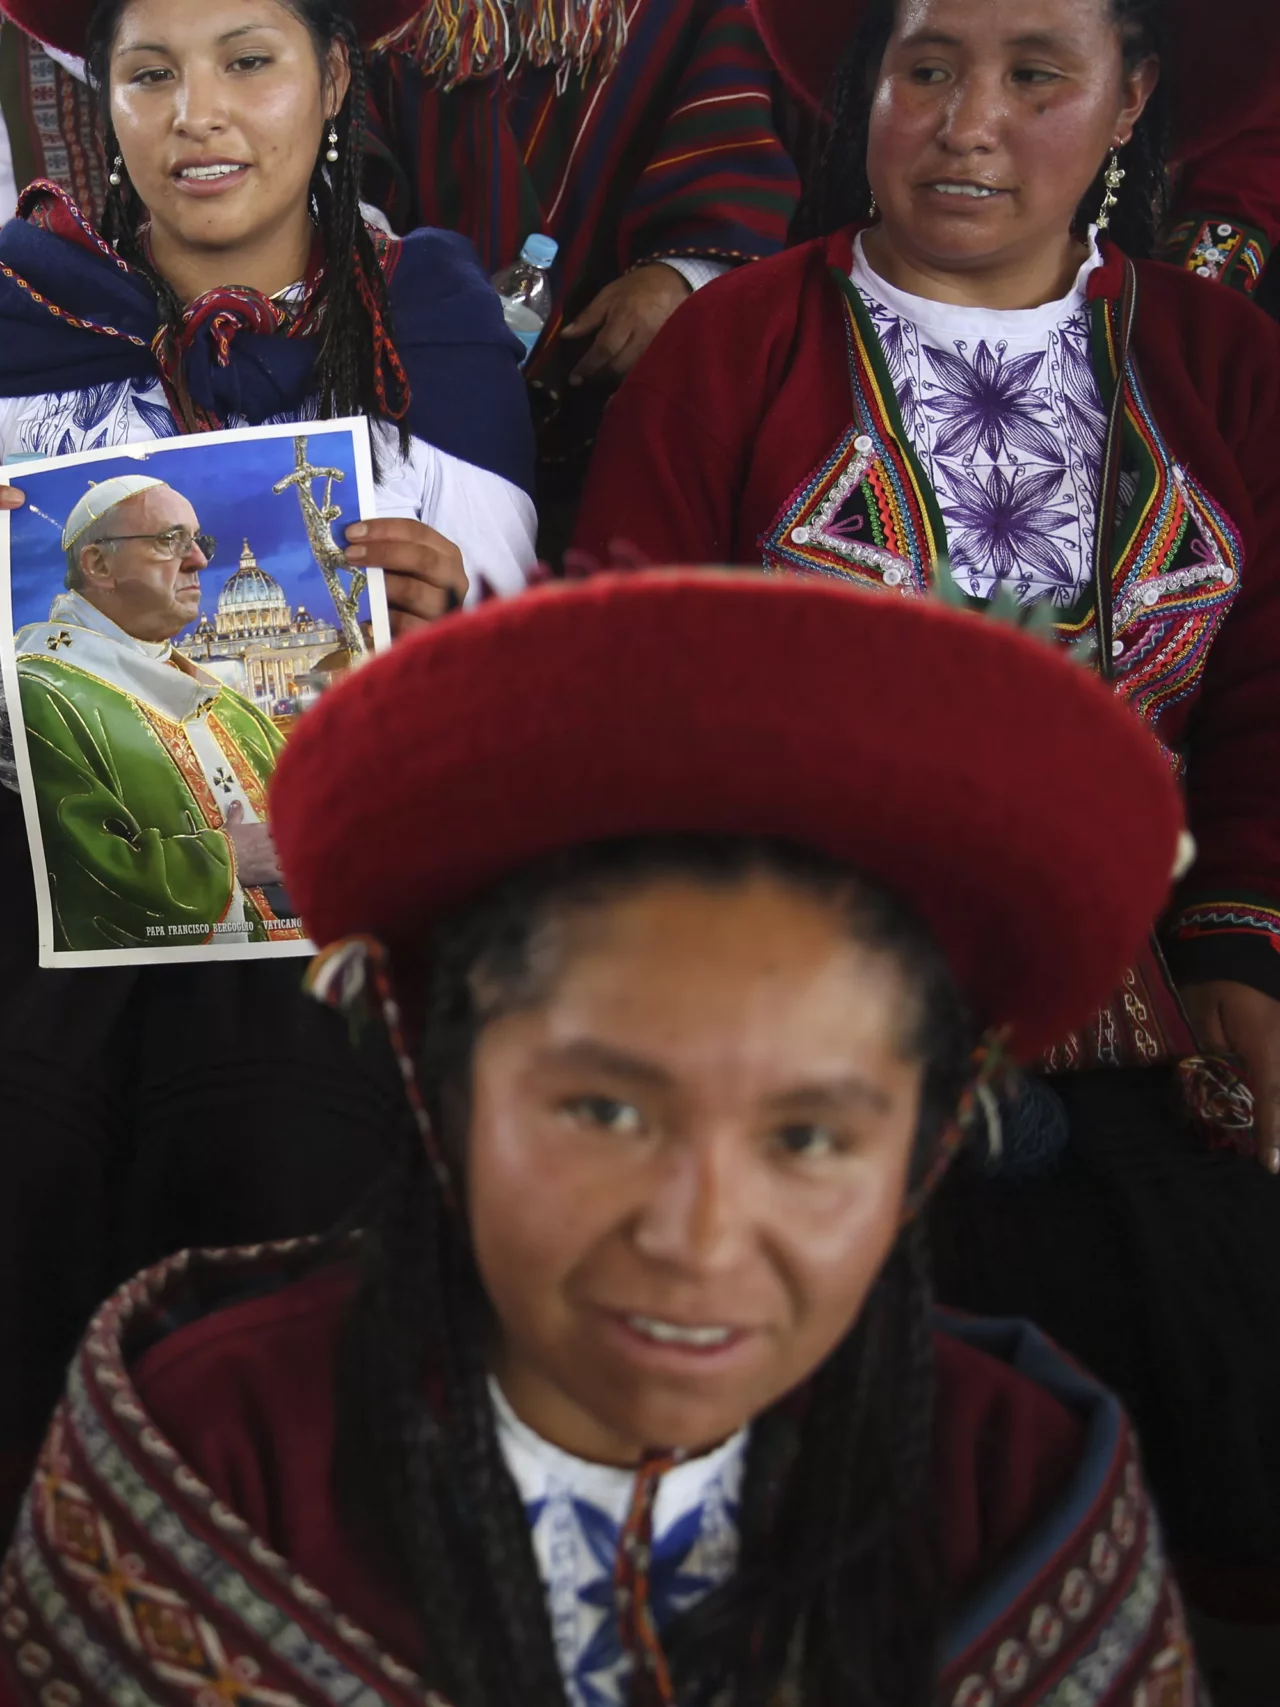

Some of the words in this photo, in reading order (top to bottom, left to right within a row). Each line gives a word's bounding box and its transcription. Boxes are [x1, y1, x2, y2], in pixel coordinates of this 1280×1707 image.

[146, 925, 166, 936] PAPA
[168, 923, 210, 935] FRANCISCO
[213, 921, 254, 933] BERGOGLIO
[261, 918, 303, 930] VATICANO
